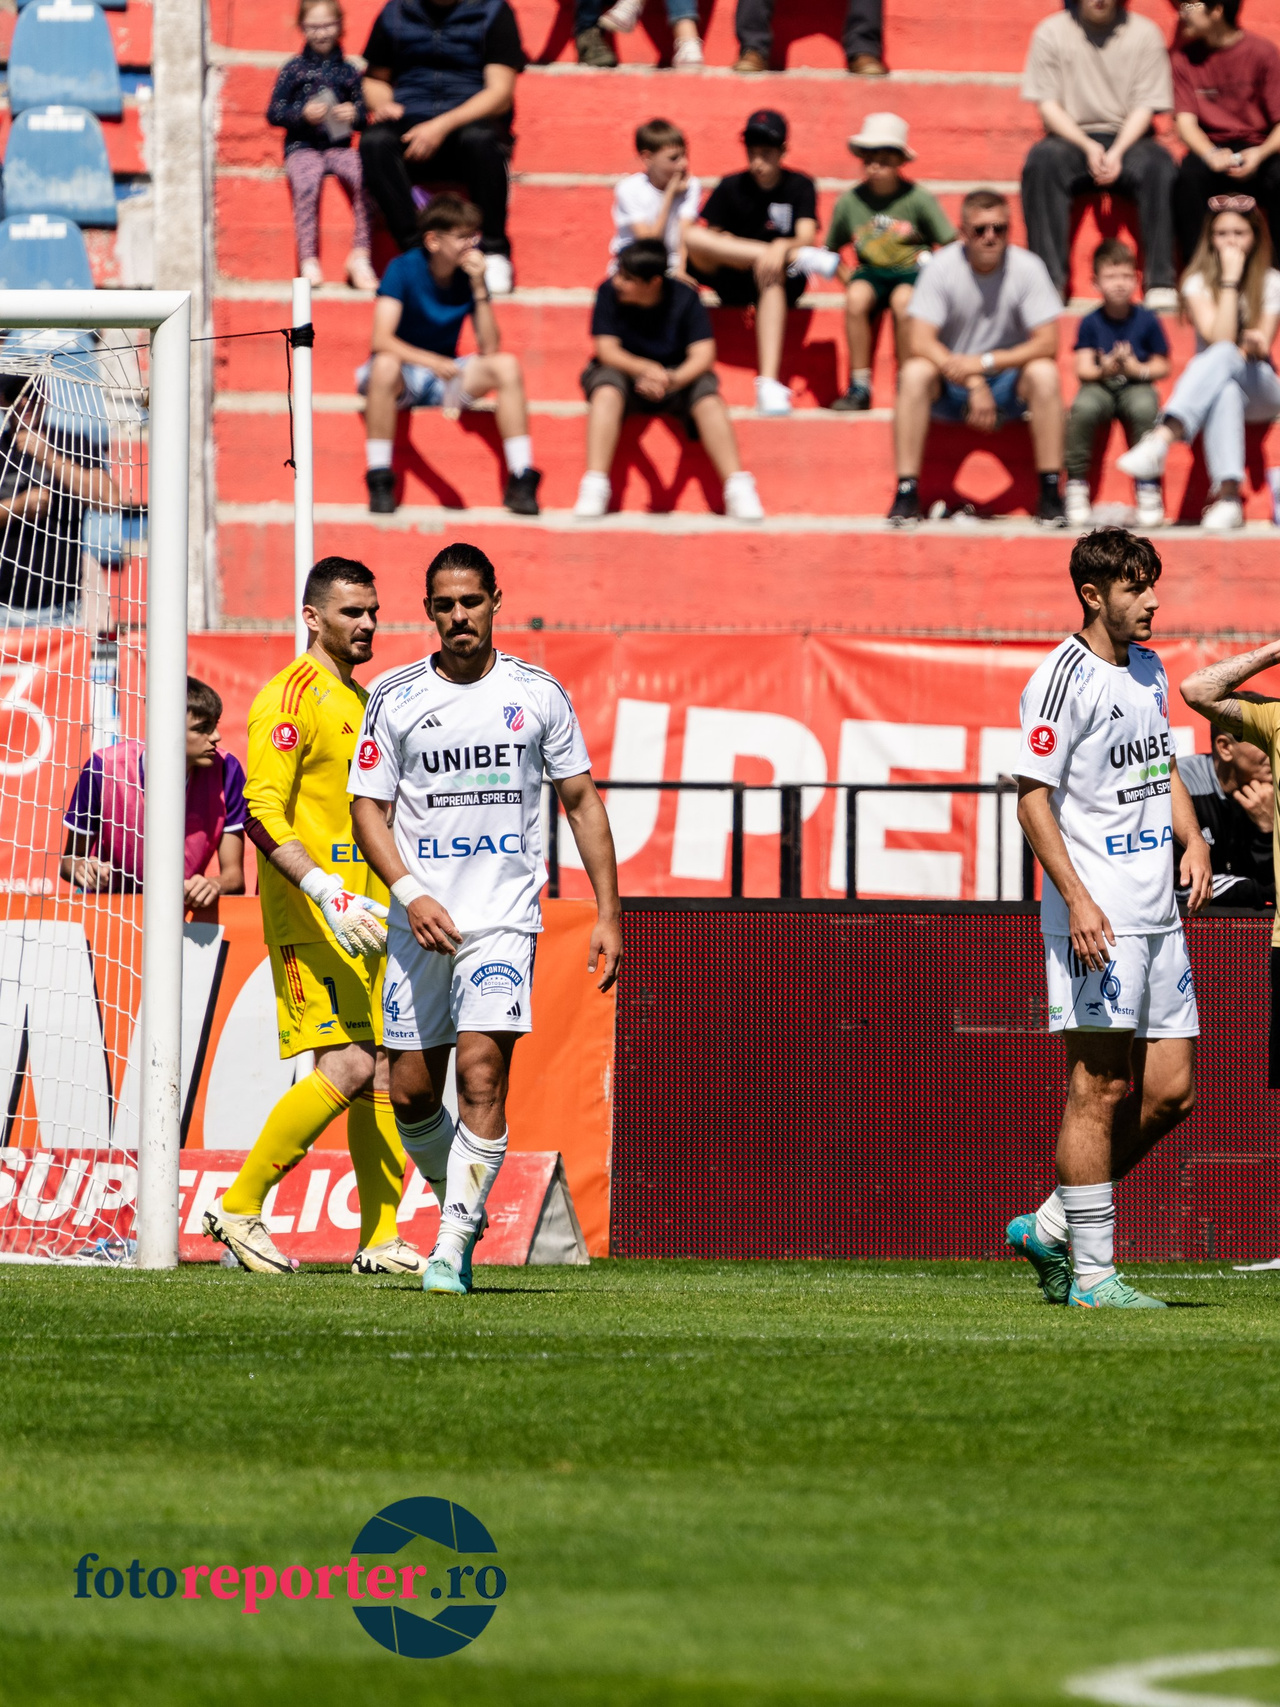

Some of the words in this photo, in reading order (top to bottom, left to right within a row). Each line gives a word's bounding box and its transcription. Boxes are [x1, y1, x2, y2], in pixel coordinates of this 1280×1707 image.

[421, 743, 527, 774] UNIBET
[432, 791, 480, 807] ÎMPREUNĂ
[481, 793, 506, 805] SPRE
[507, 792, 521, 804] 0%
[472, 970, 485, 984] FIVE
[483, 965, 521, 983] CONTINENTS
[1100, 960, 1121, 1001] 6
[323, 976, 339, 1015] 1
[1110, 1005, 1135, 1016] Vestra
[345, 1020, 372, 1030] Vestra
[385, 1027, 415, 1038] Vestra
